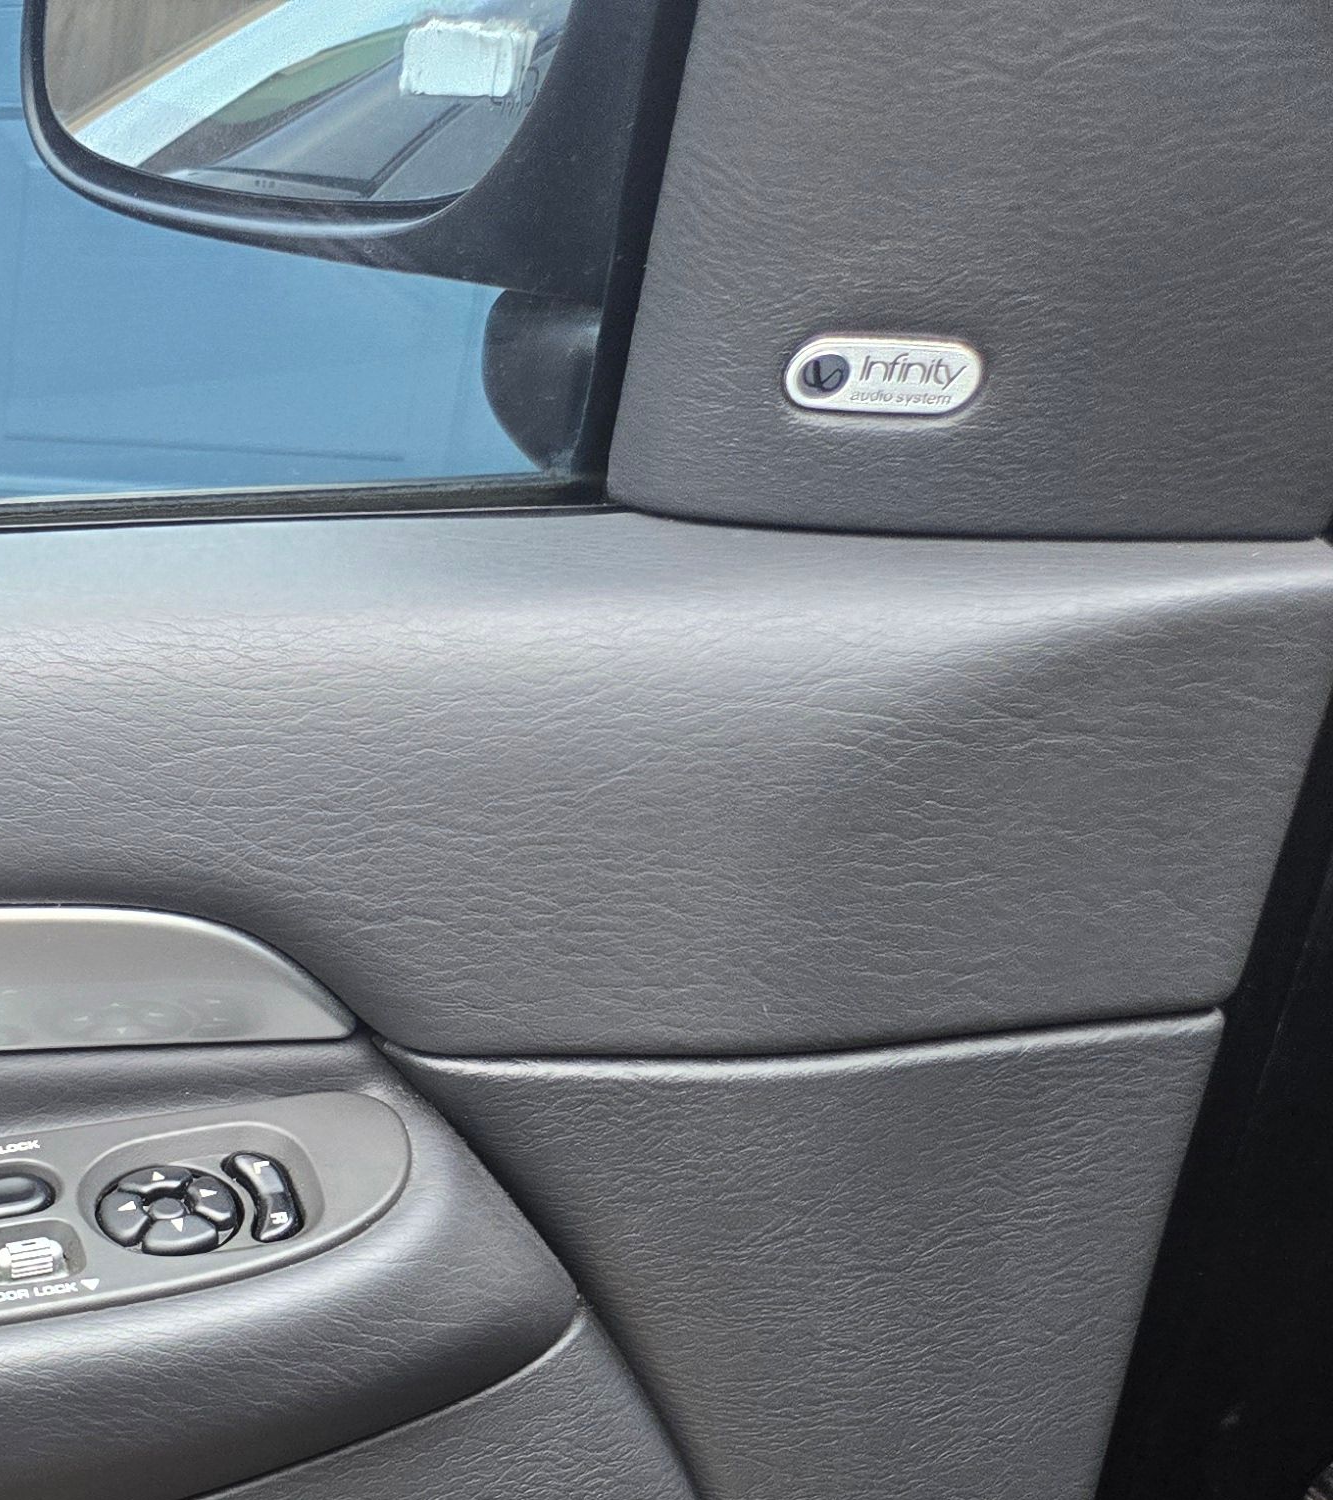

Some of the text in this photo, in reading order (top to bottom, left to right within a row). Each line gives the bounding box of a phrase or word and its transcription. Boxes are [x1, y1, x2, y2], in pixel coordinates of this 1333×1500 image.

[859, 352, 967, 391] Infinity
[849, 389, 952, 407] audio system
[253, 1160, 270, 1175] L
[270, 1211, 289, 1225] R
[33, 1281, 78, 1297] LOCK
